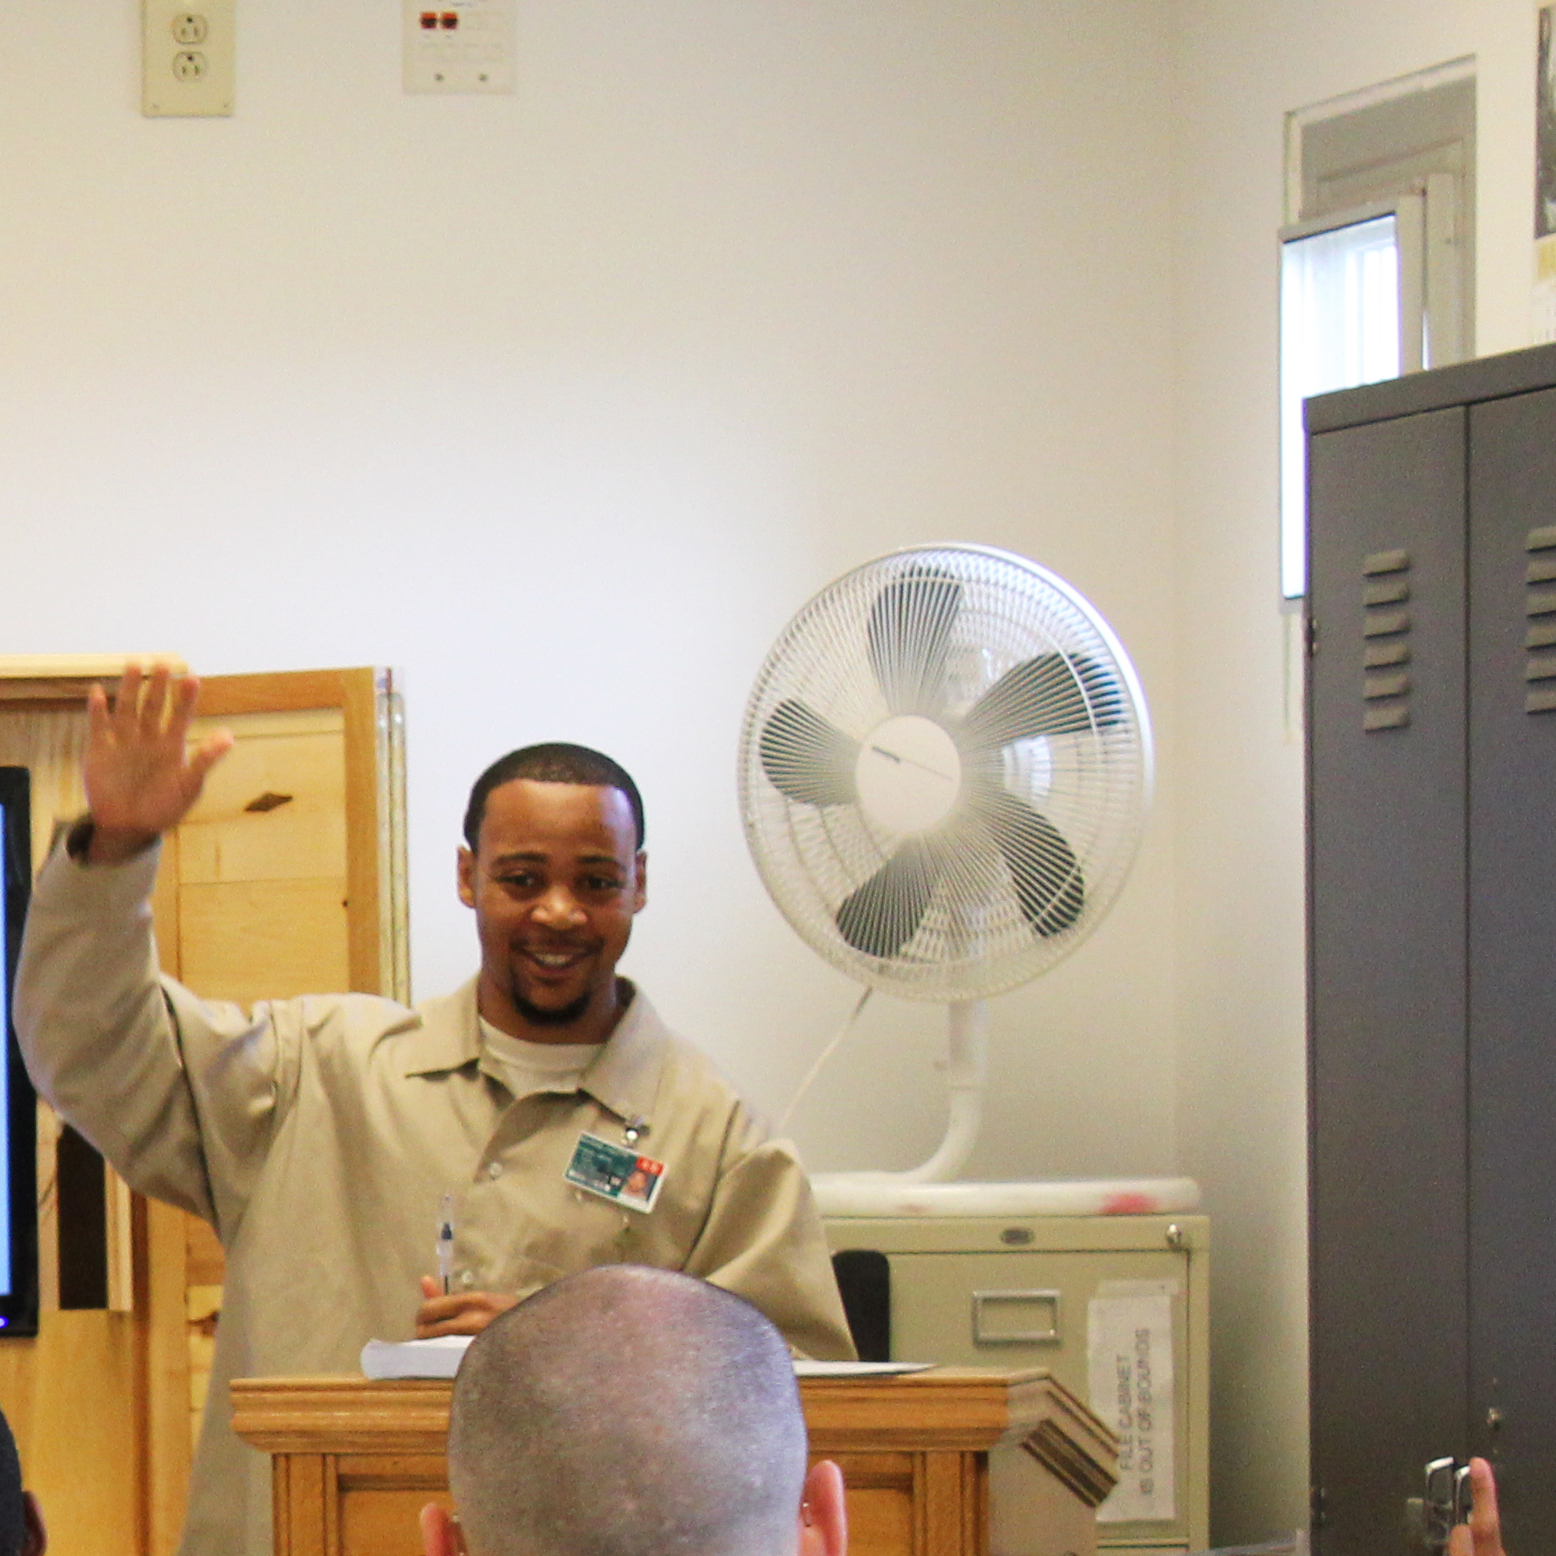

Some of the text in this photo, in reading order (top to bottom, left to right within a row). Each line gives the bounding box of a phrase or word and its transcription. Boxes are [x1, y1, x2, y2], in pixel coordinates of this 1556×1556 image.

[1115, 1353, 1133, 1470] FILE CABINET
[1134, 1328, 1155, 1495] IS OUT OF BOUNDS
